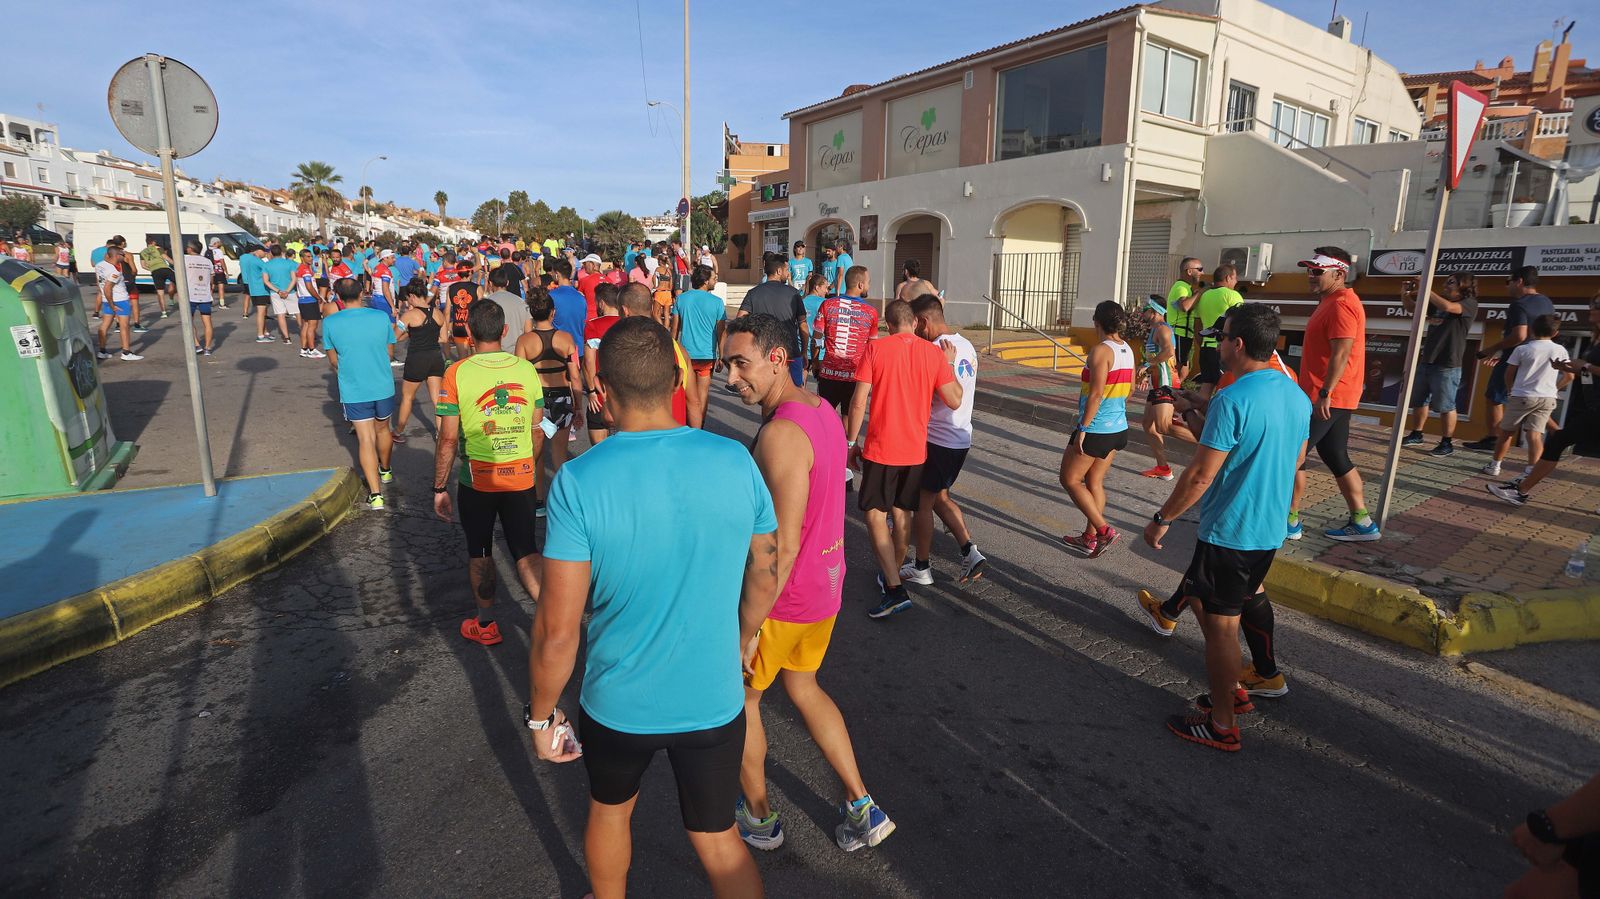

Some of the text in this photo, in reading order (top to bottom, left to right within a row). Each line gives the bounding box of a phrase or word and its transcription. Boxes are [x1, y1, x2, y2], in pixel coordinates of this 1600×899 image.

[900, 126, 949, 156] Cepas
[818, 145, 855, 171] Cepas
[819, 202, 839, 217] Cepas
[1439, 251, 1512, 261] PANADERIA
[1437, 262, 1511, 272] PASTELERIA
